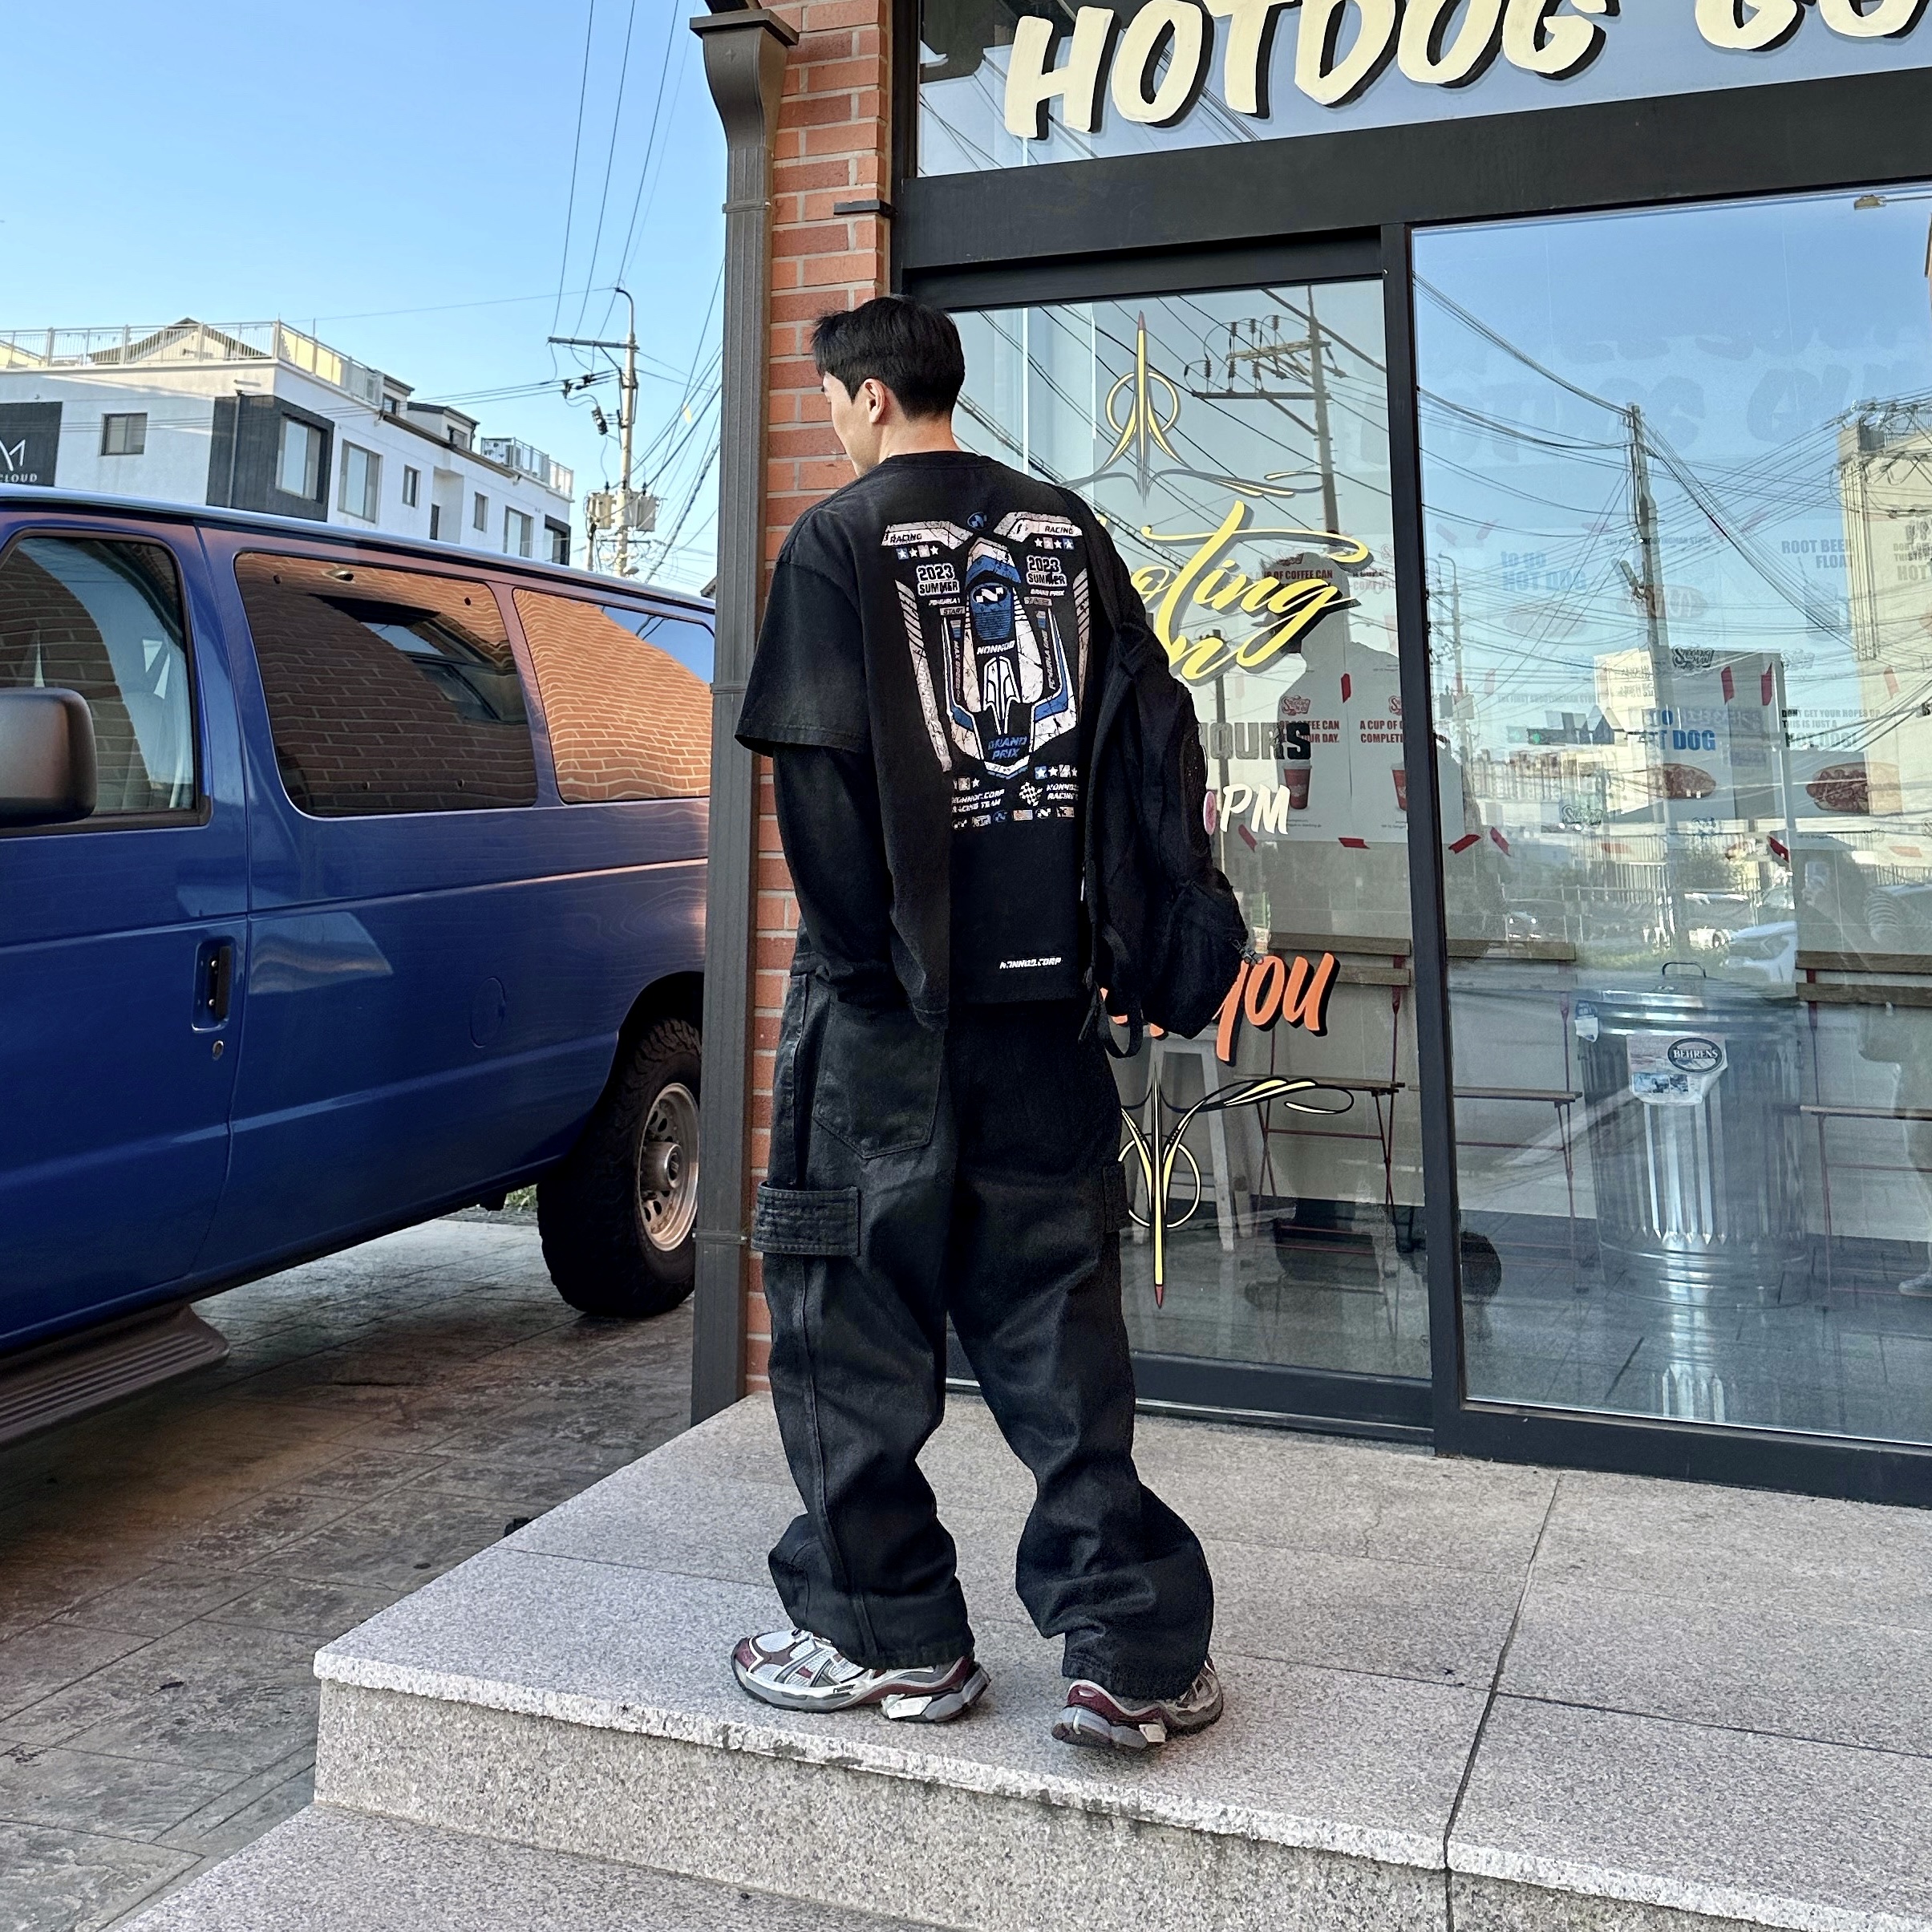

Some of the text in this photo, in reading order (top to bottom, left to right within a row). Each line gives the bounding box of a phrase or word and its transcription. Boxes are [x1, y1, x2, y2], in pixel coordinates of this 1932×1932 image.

[1005, 0, 1606, 140] HOTDOG
[1045, 525, 1074, 535] RACING
[889, 533, 922, 543] RACING
[1781, 540, 1818, 554] ROOT
[1027, 555, 1060, 573] 2023
[917, 565, 954, 581] 2023
[1027, 573, 1066, 585] SUMMER
[1285, 569, 1314, 579] COFFEE
[1315, 569, 1333, 579] CAN
[919, 581, 959, 594] SUMMER
[1131, 500, 1370, 668] oting
[1804, 709, 1819, 718] GET
[1819, 709, 1841, 718] YOUR
[1842, 709, 1869, 719] HOPES
[1323, 720, 1340, 730] CAN
[1359, 720, 1366, 730] A
[1368, 720, 1385, 730] CUP
[1387, 720, 1398, 730] OF
[987, 735, 1028, 751] GRAND
[1322, 733, 1340, 743] DAY.
[1673, 729, 1716, 751] DOG
[991, 747, 1022, 762] PRIX
[1220, 783, 1291, 835] PM
[1673, 1048, 1719, 1059] BEHRENS
